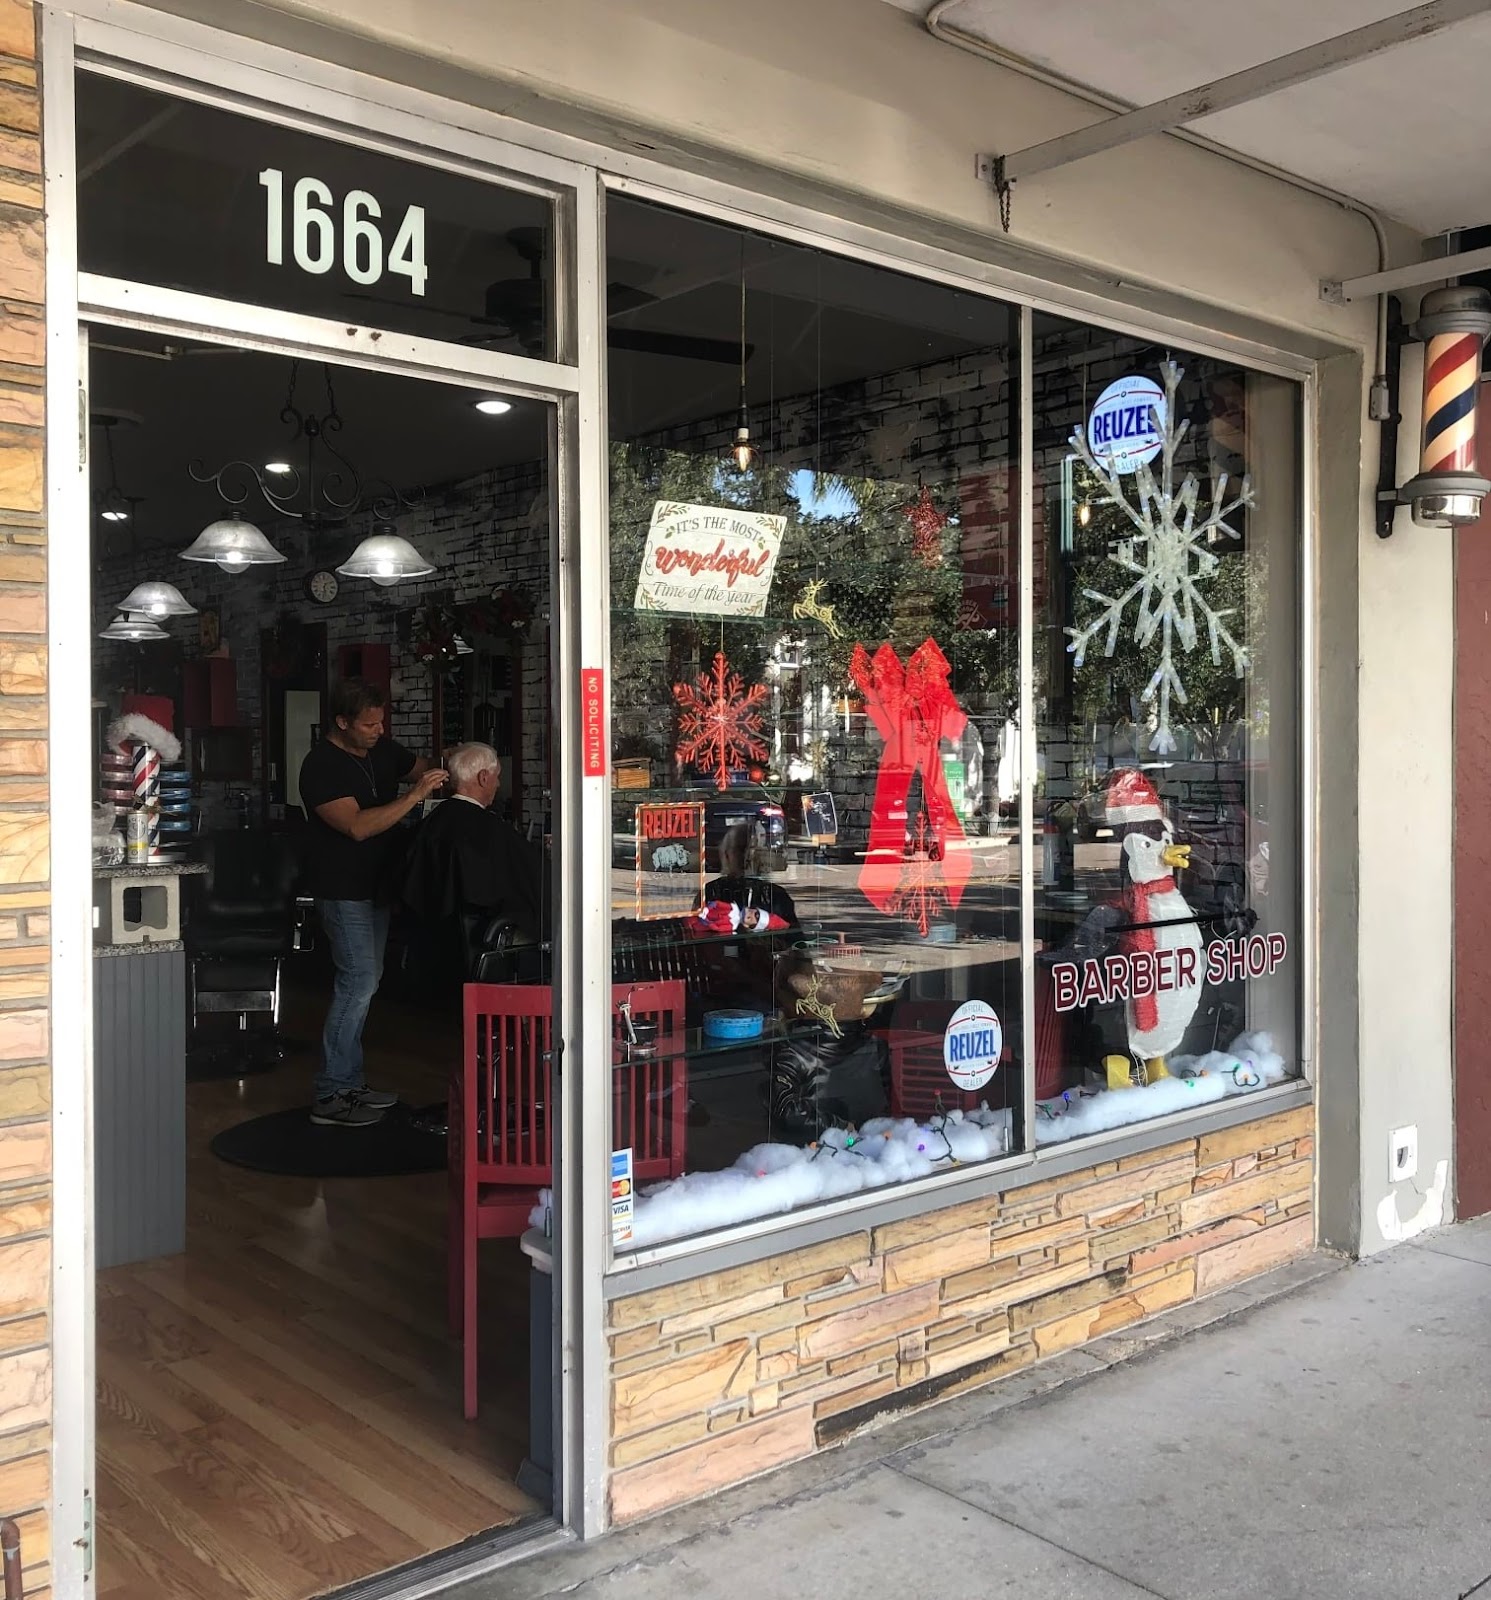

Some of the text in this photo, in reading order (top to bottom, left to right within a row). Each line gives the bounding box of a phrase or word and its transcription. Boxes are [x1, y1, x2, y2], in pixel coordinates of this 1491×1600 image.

[258, 167, 428, 296] 1664
[675, 516, 762, 542] IT'S THE MOST
[655, 538, 770, 588] wonderful
[653, 581, 758, 607] Time of the year
[588, 676, 600, 768] NO SOLICITING
[643, 808, 697, 839] REUZEL
[1052, 932, 1287, 1012] BARBER SHOP
[950, 1029, 996, 1062] REUZEL
[613, 1204, 629, 1215] VISA
